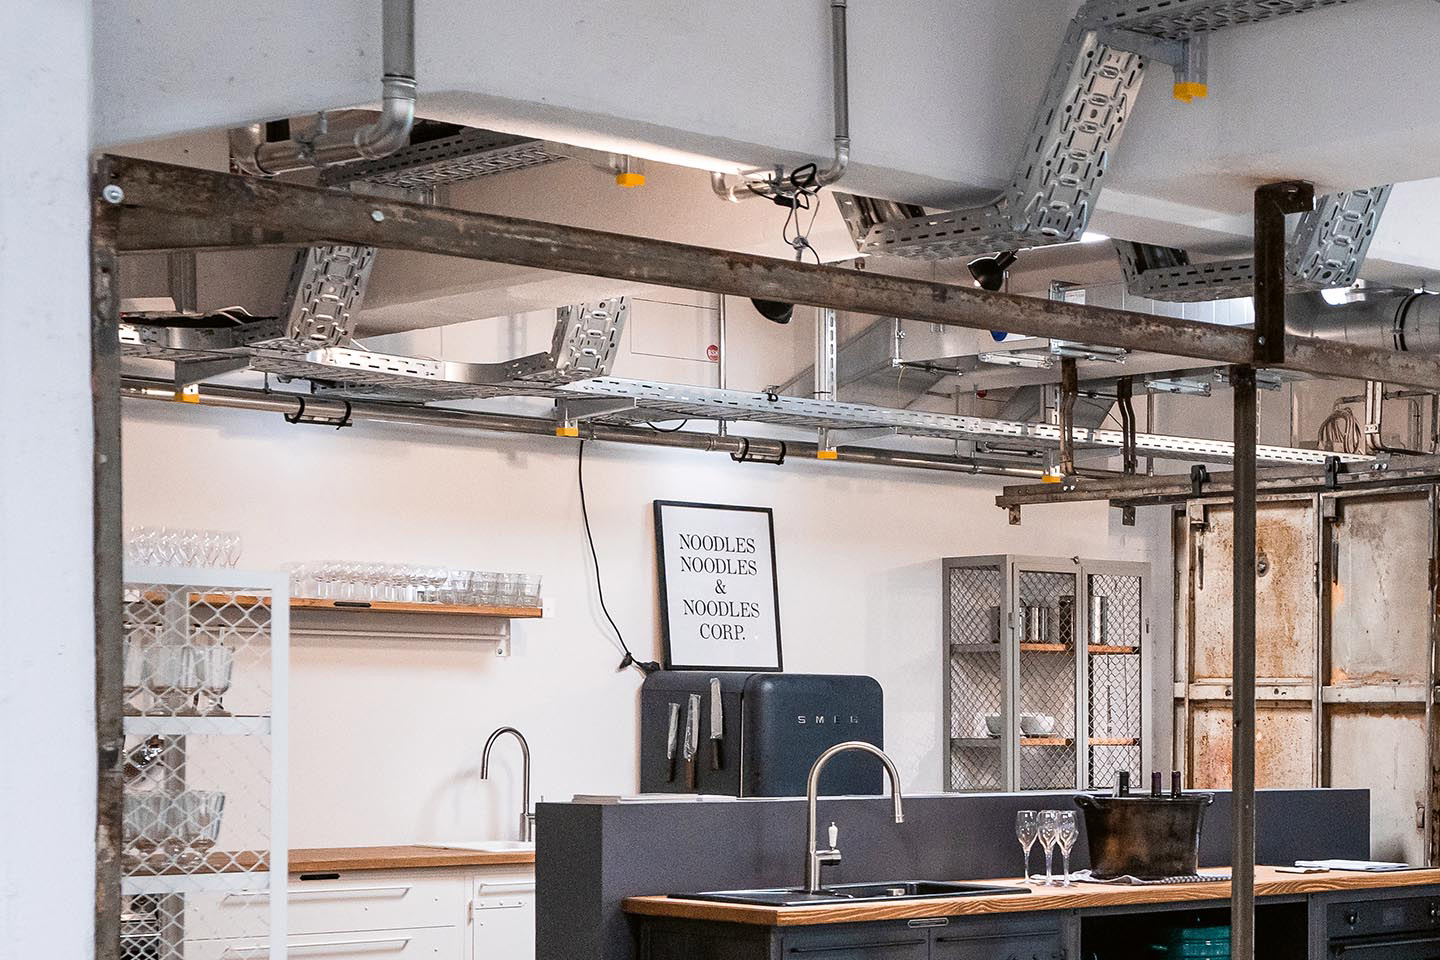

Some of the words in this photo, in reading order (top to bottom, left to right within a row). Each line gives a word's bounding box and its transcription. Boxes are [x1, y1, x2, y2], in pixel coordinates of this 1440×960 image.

[679, 533, 756, 554] NOODLES
[680, 555, 758, 576] NOODLES
[714, 578, 727, 595] &
[683, 599, 760, 619] NOODLES
[699, 622, 746, 641] CORP.
